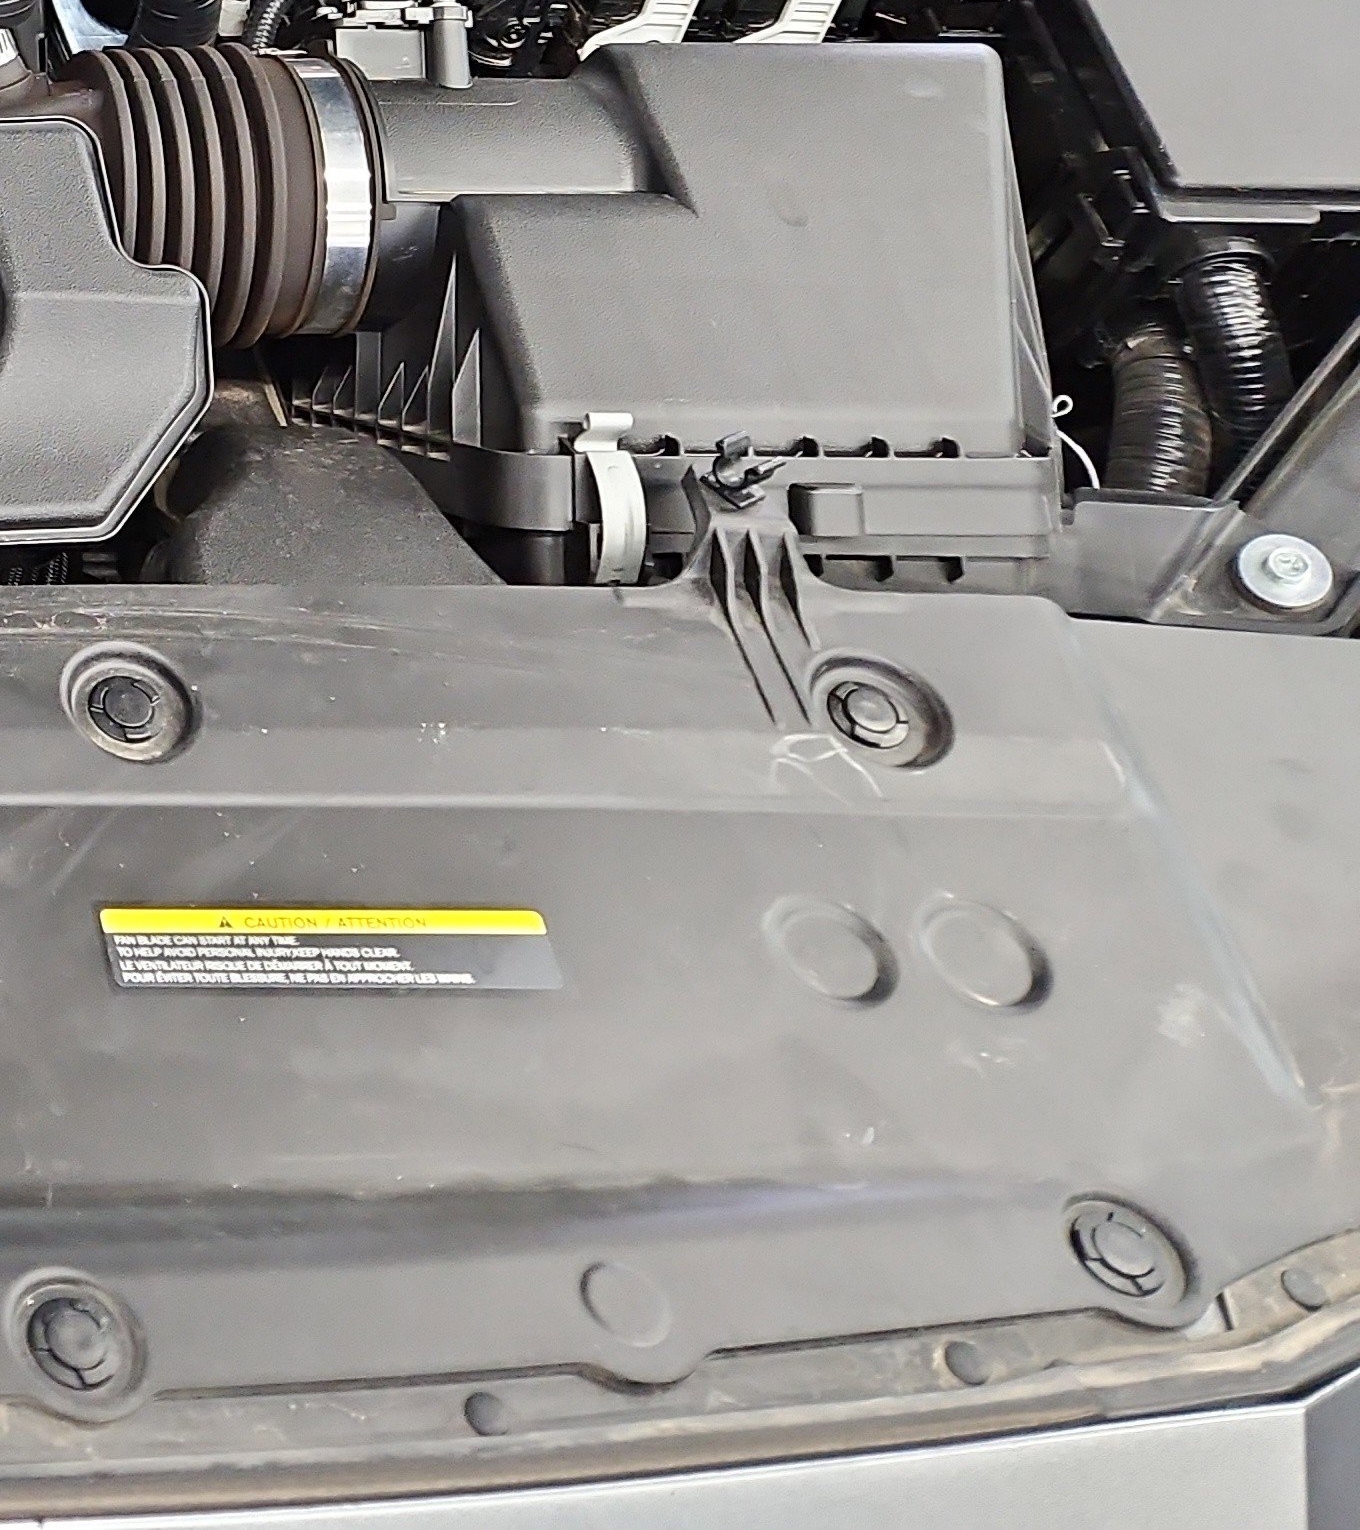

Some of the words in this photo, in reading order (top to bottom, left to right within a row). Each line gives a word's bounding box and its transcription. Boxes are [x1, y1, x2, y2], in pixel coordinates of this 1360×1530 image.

[244, 917, 318, 928] CAUTION
[338, 917, 427, 929] ATTENTION
[114, 935, 136, 945] FAN
[136, 935, 172, 945] BLADE
[173, 935, 198, 945] CAN
[198, 935, 231, 945] START
[233, 935, 247, 945] AT
[247, 935, 271, 945] ANY
[116, 947, 134, 957] TO
[134, 947, 163, 957] HELP
[163, 947, 196, 958] AVOID
[196, 947, 256, 958] PERSONAL
[320, 947, 360, 958] HANDS
[119, 960, 136, 970] LE
[136, 960, 203, 971] VENTILATEUR
[204, 960, 247, 971] RISQUE
[247, 960, 262, 971] DE
[334, 960, 364, 971] TOUT
[122, 972, 155, 983] POUR
[194, 972, 230, 983] TOUTE
